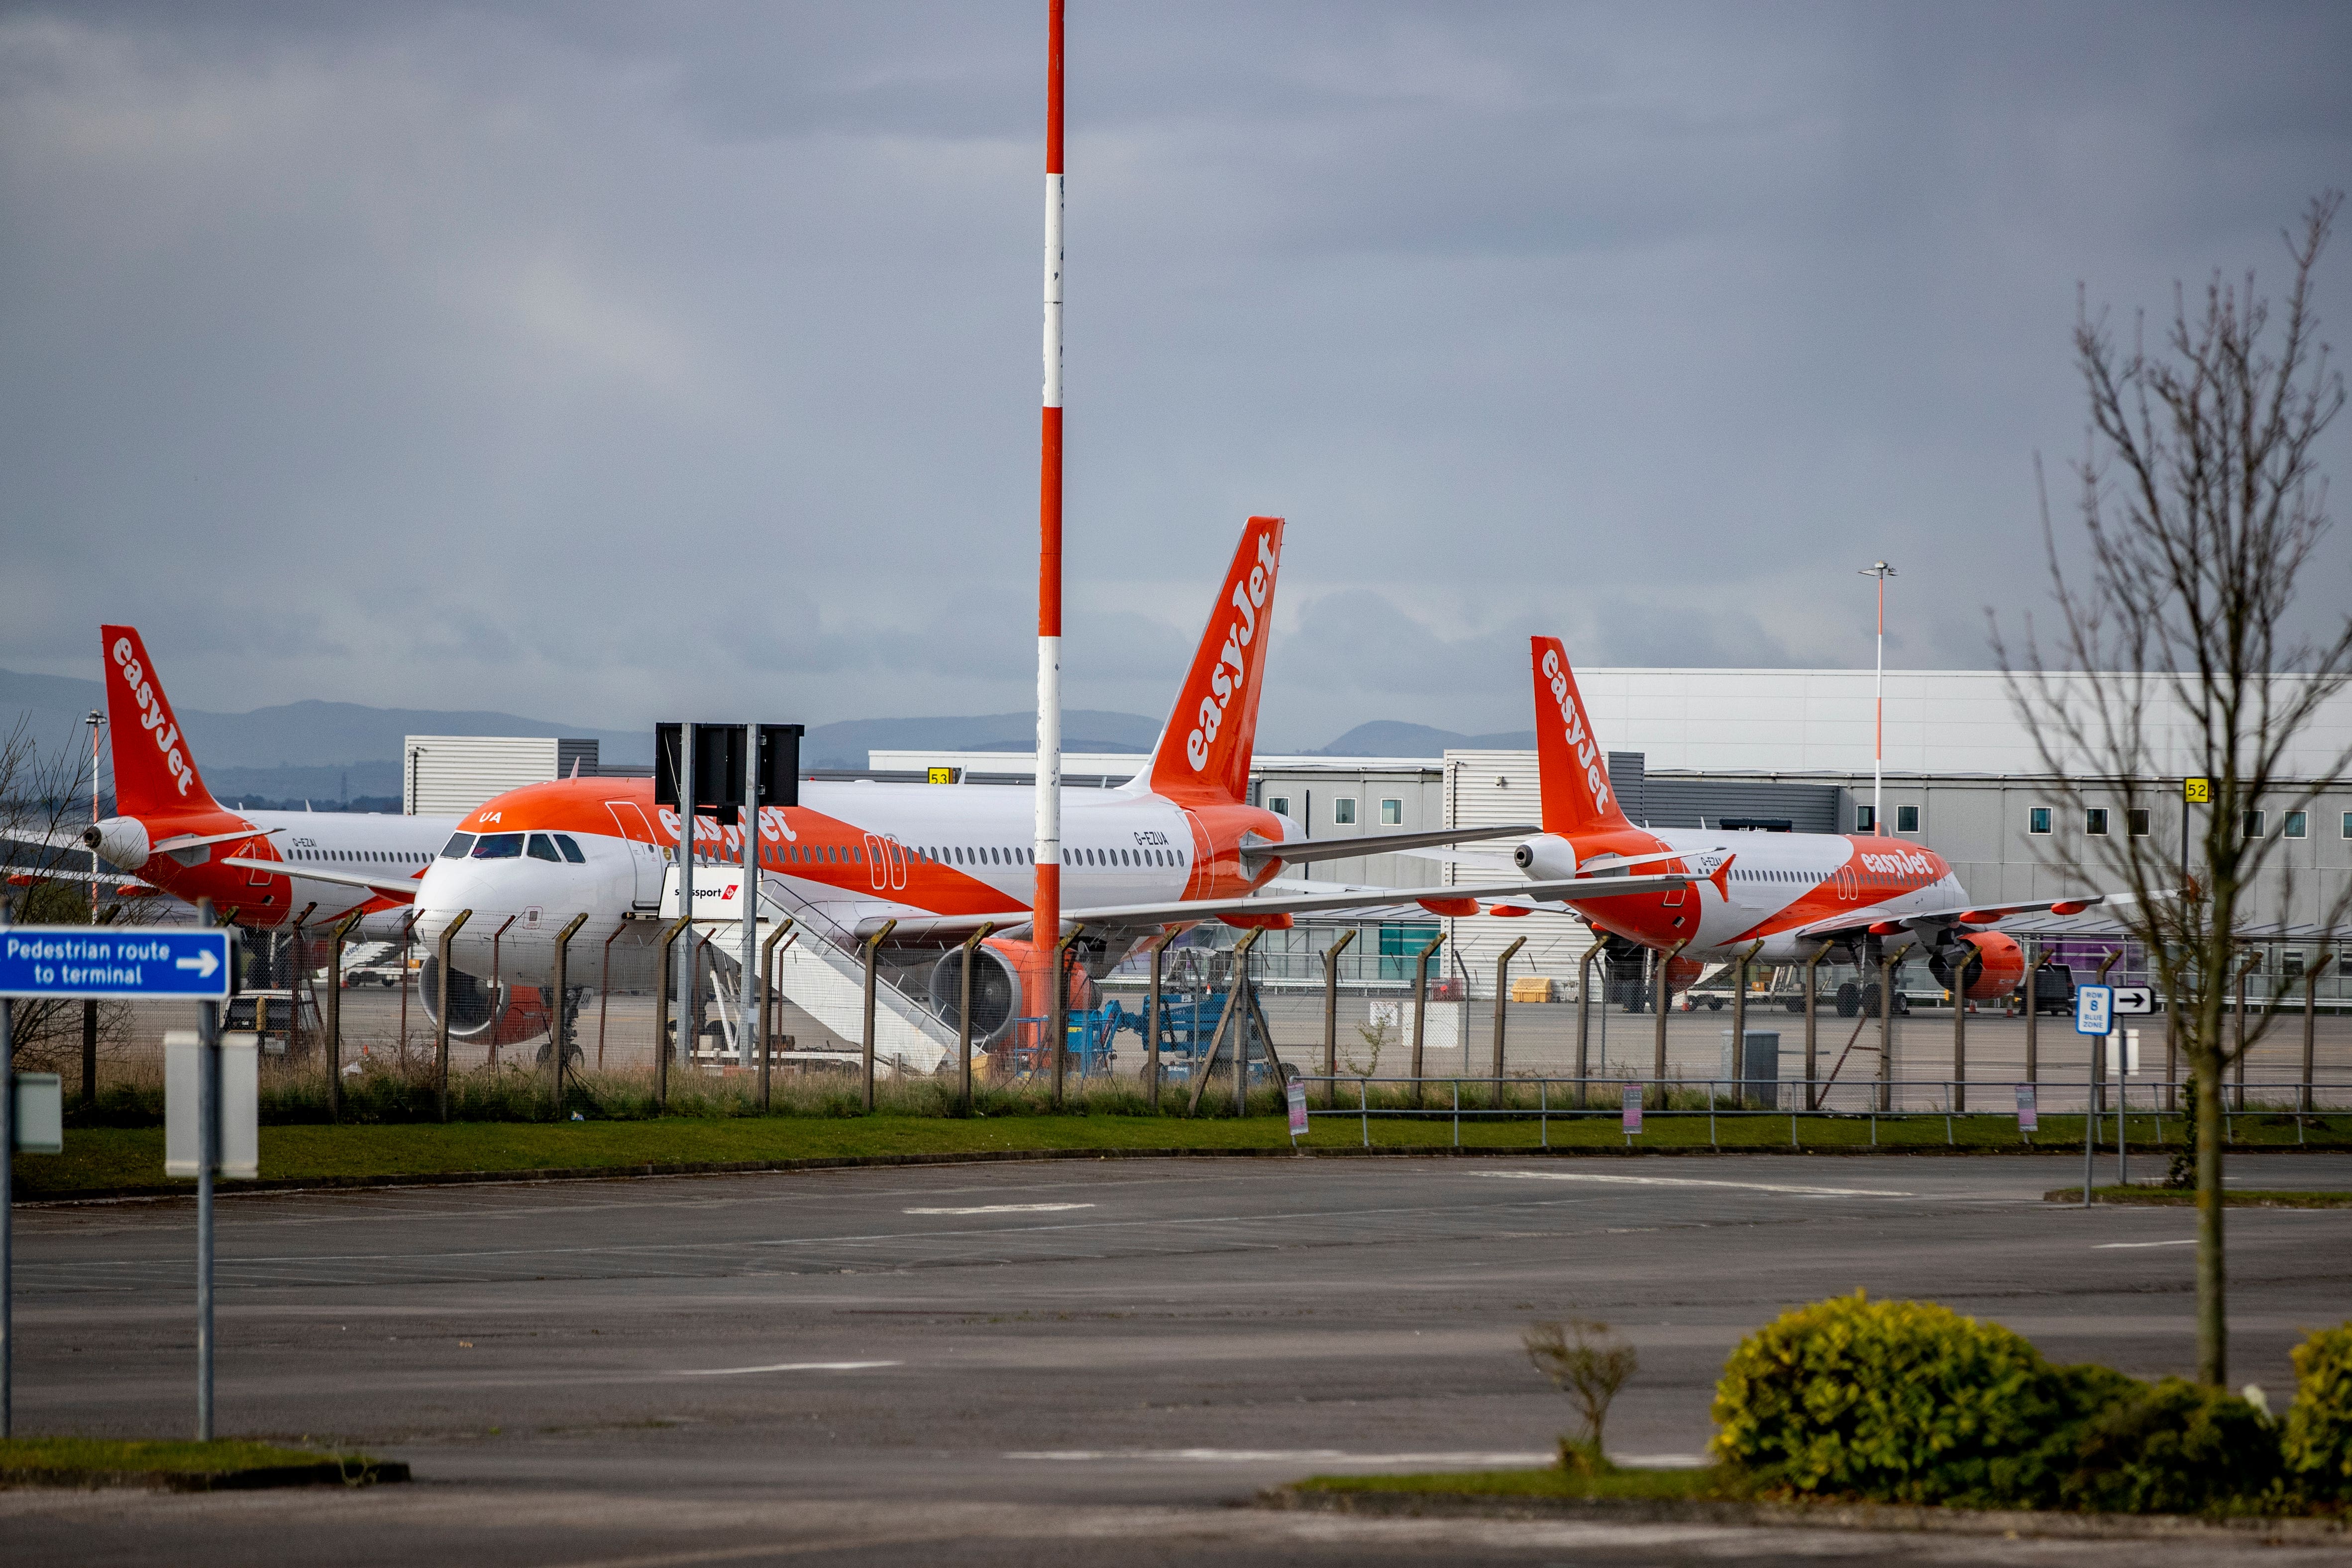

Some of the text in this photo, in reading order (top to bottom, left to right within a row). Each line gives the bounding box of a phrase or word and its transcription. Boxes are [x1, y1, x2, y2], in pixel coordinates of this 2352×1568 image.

[1187, 532, 1275, 771] easyJet
[113, 637, 193, 796] easyJet
[1542, 649, 1608, 815] easyJet
[932, 774, 947, 784] 53
[2188, 784, 2206, 796] 52
[479, 812, 502, 824] UA
[293, 838, 318, 847] G-EZAI
[1134, 832, 1169, 845] G-EZUA
[1861, 849, 1934, 879] easyJet
[675, 888, 722, 899] sssport
[7, 938, 171, 961] Pedestrian route
[34, 962, 143, 985] to terminal
[2090, 1000, 2098, 1012] 8
